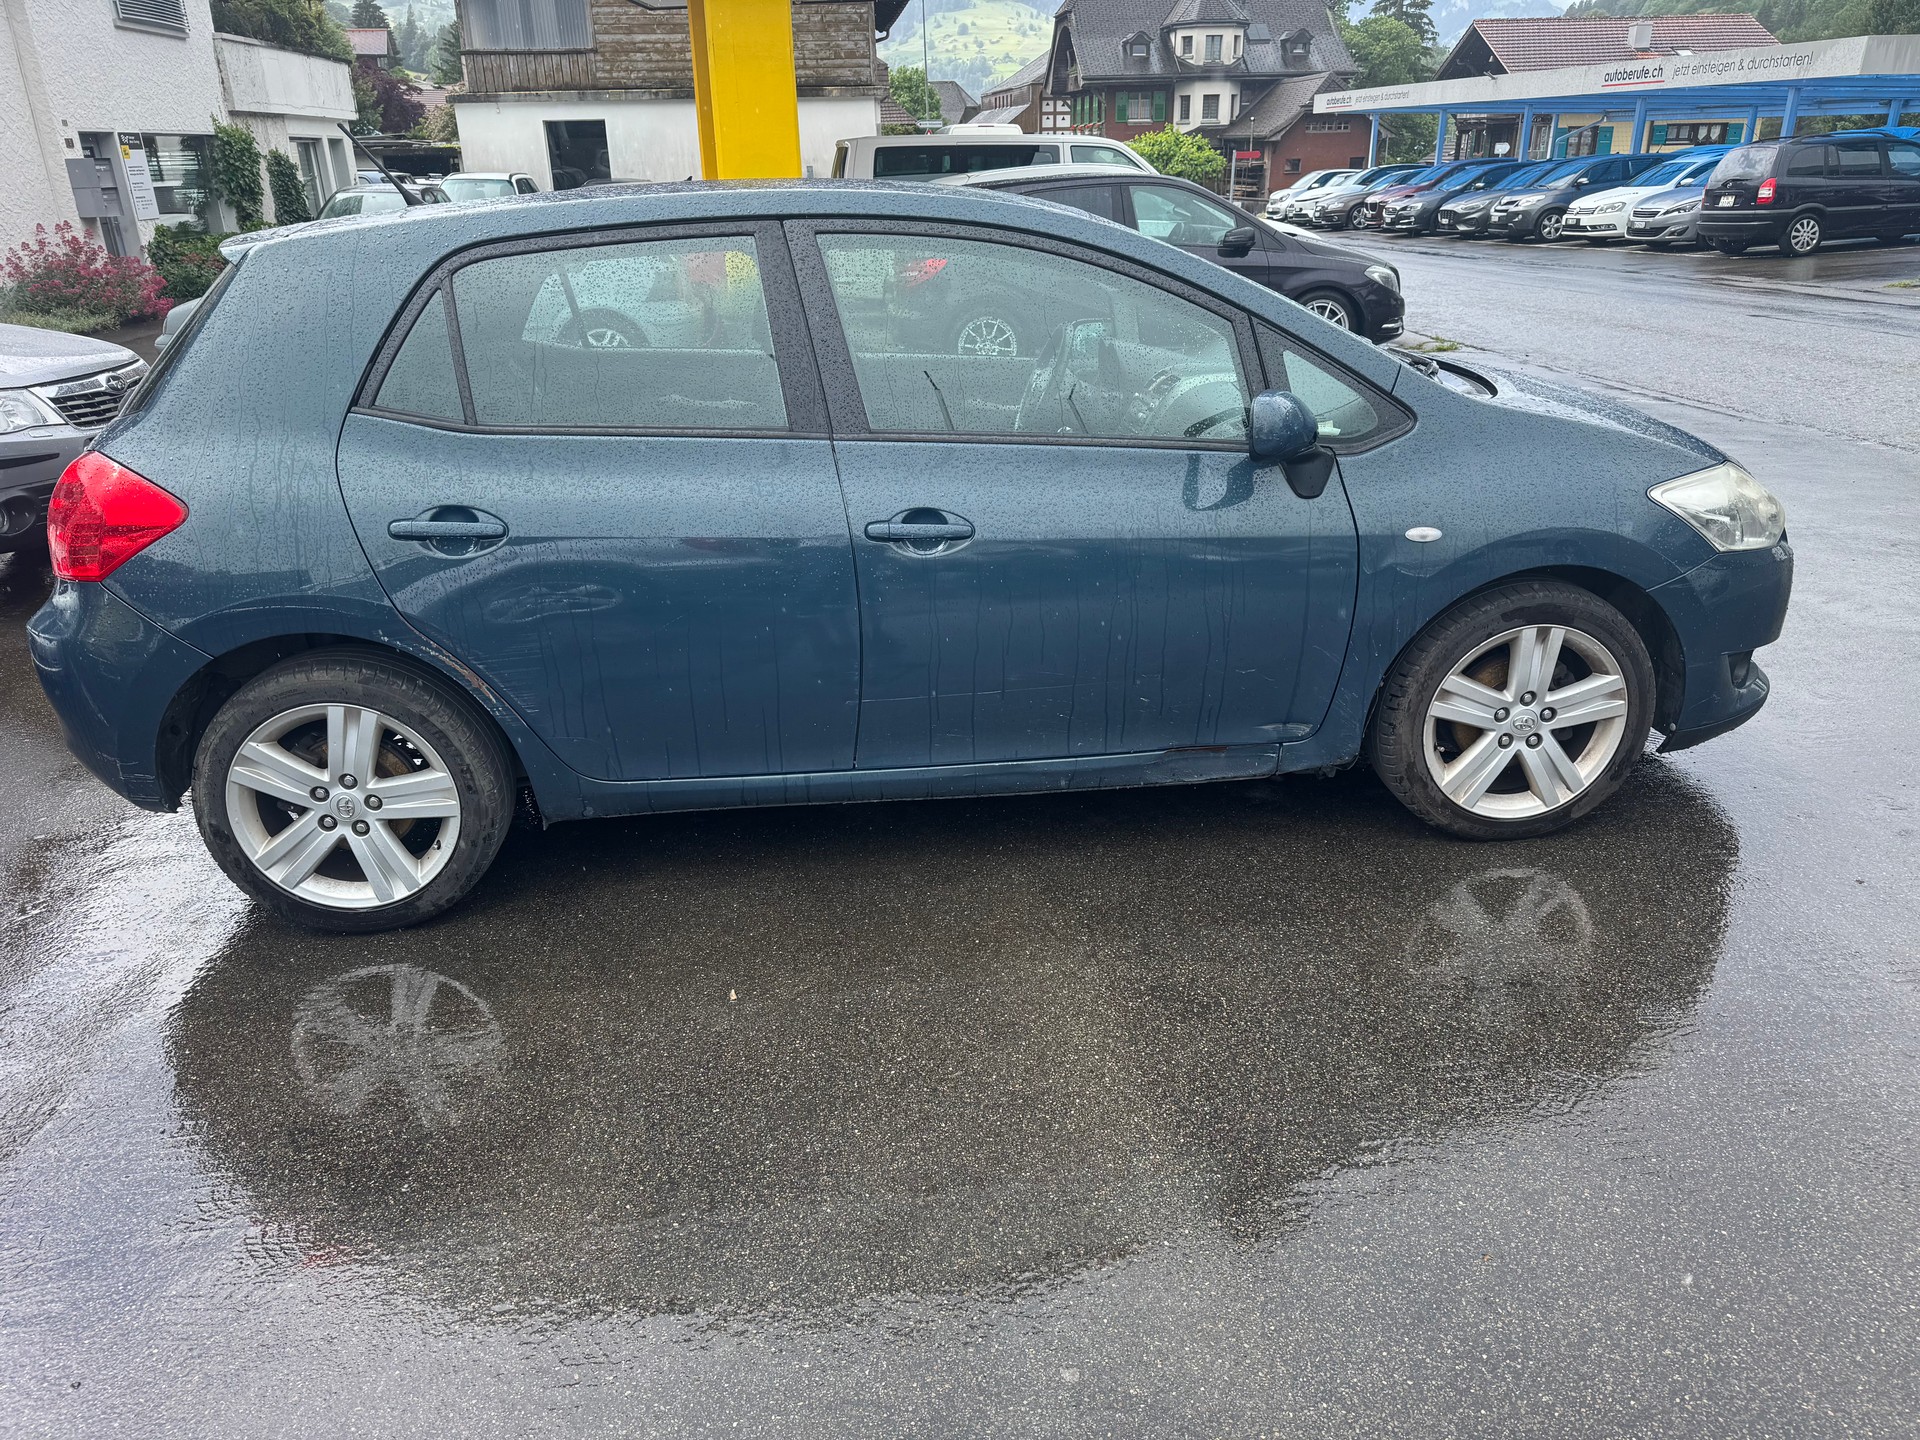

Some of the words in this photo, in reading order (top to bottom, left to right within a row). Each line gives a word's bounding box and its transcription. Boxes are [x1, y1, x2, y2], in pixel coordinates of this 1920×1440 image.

[1604, 64, 1663, 82] autoberufe.ch
[1671, 63, 1690, 80] jetzt
[1691, 60, 1736, 76] einsteigen
[1738, 58, 1744, 71] &
[1747, 51, 1814, 70] durchstarten!
[1326, 95, 1352, 106] autoberufe.ch
